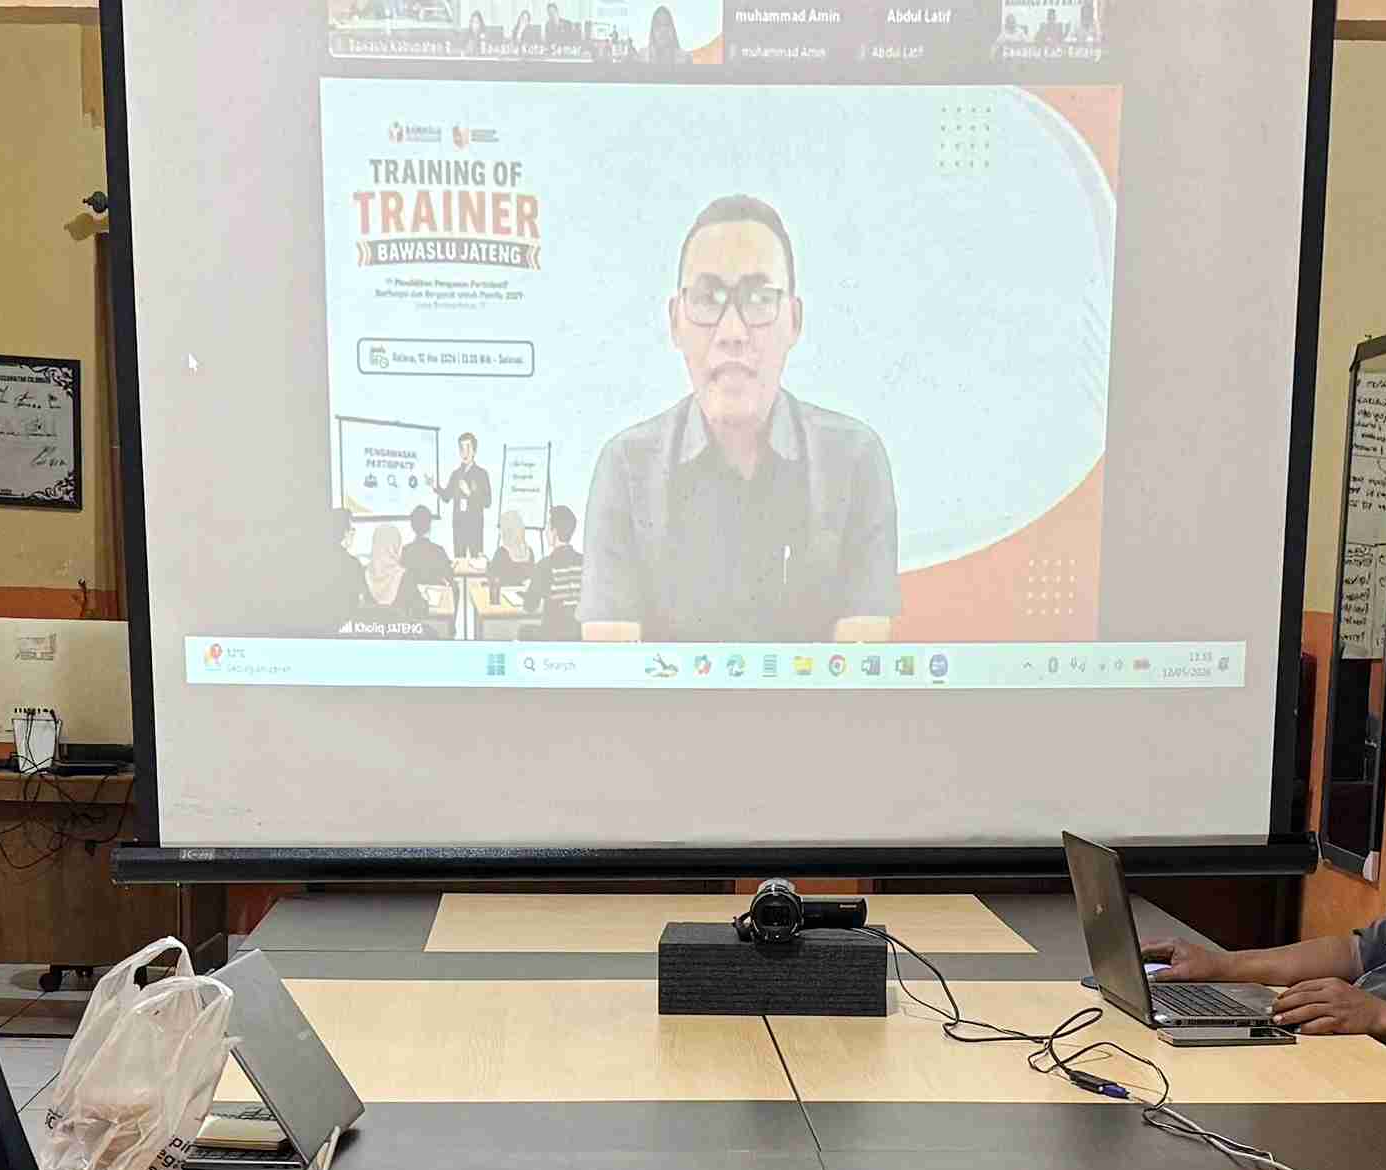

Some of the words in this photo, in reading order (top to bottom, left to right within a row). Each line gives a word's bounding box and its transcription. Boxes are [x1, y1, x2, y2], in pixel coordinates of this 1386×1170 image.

[369, 158, 487, 186] TRAINING
[492, 160, 523, 188] OF
[353, 189, 541, 239] TRAINER
[377, 240, 456, 263] BAWASLU
[461, 242, 522, 265] JATENG
